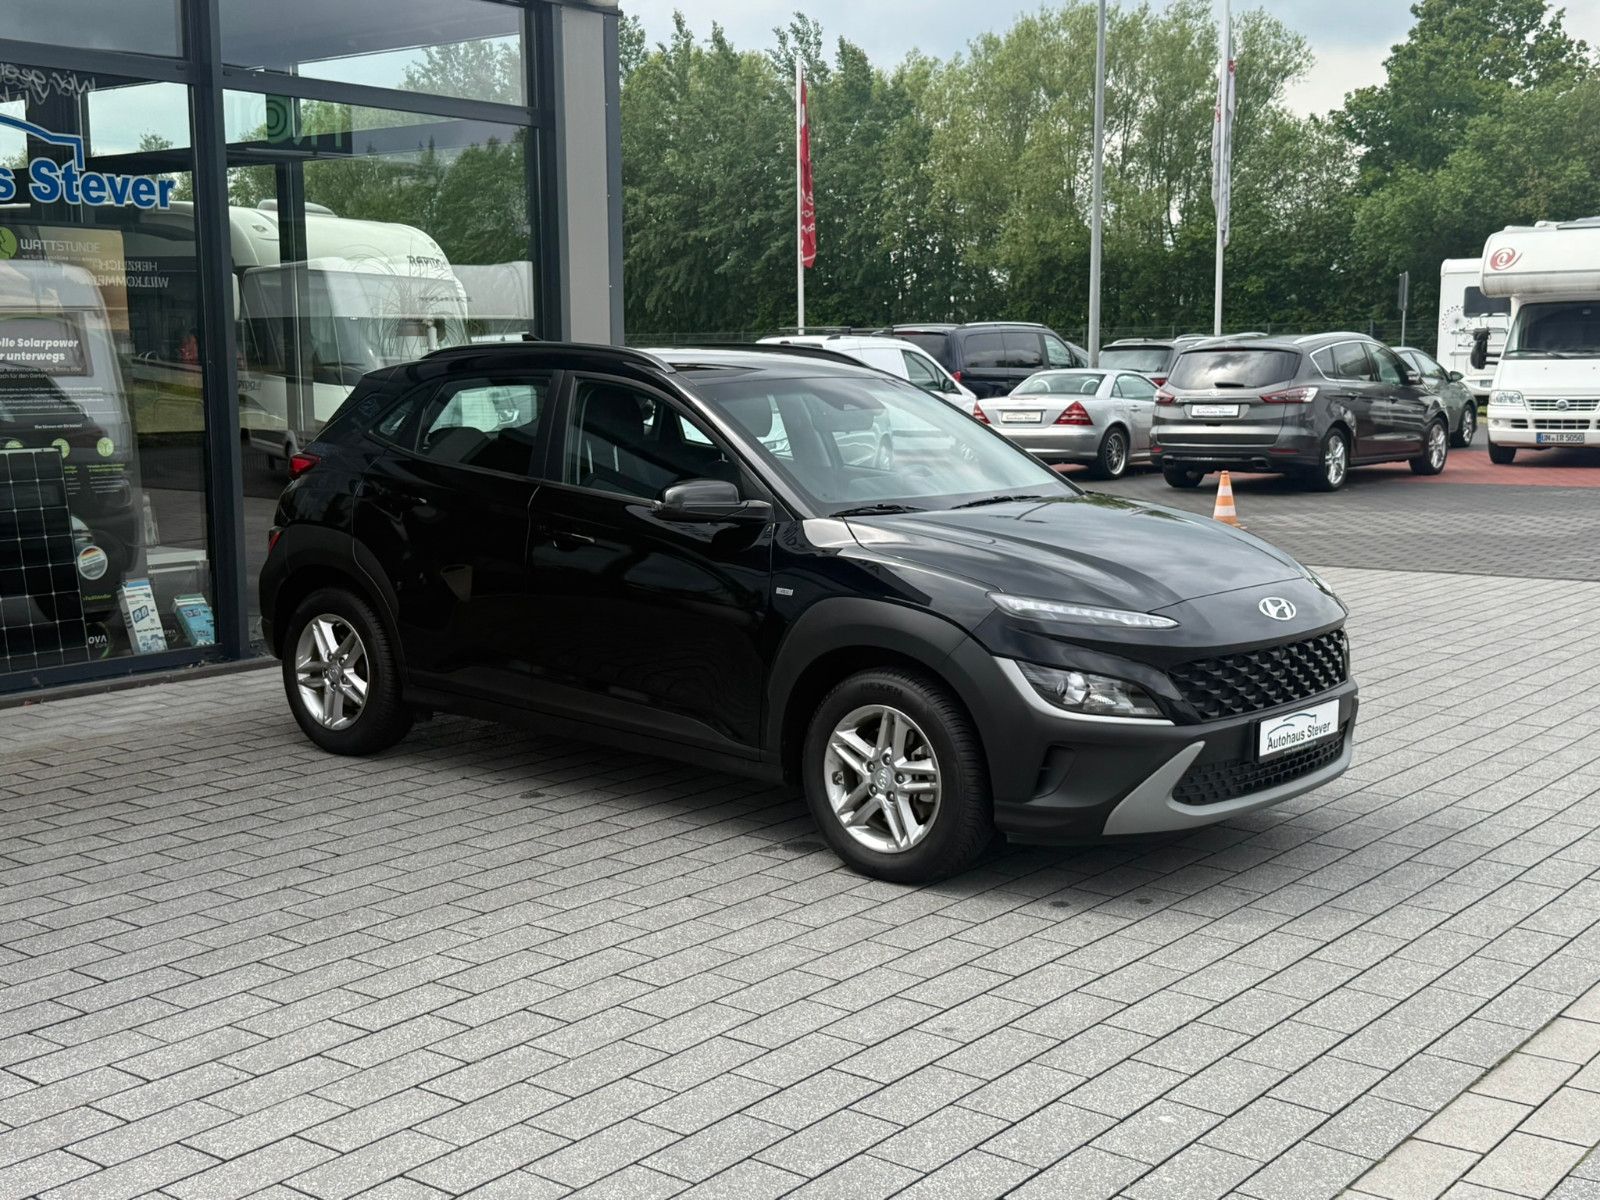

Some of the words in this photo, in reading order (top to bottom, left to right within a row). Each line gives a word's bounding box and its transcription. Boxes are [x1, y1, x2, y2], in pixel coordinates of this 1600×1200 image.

[29, 157, 176, 210] Stever
[20, 239, 101, 254] WATTSTUNDE
[17, 338, 79, 350] Solarpower
[6, 352, 65, 363] unterwegs
[1266, 730, 1305, 750] Autohaus
[1307, 722, 1331, 738] Stever
